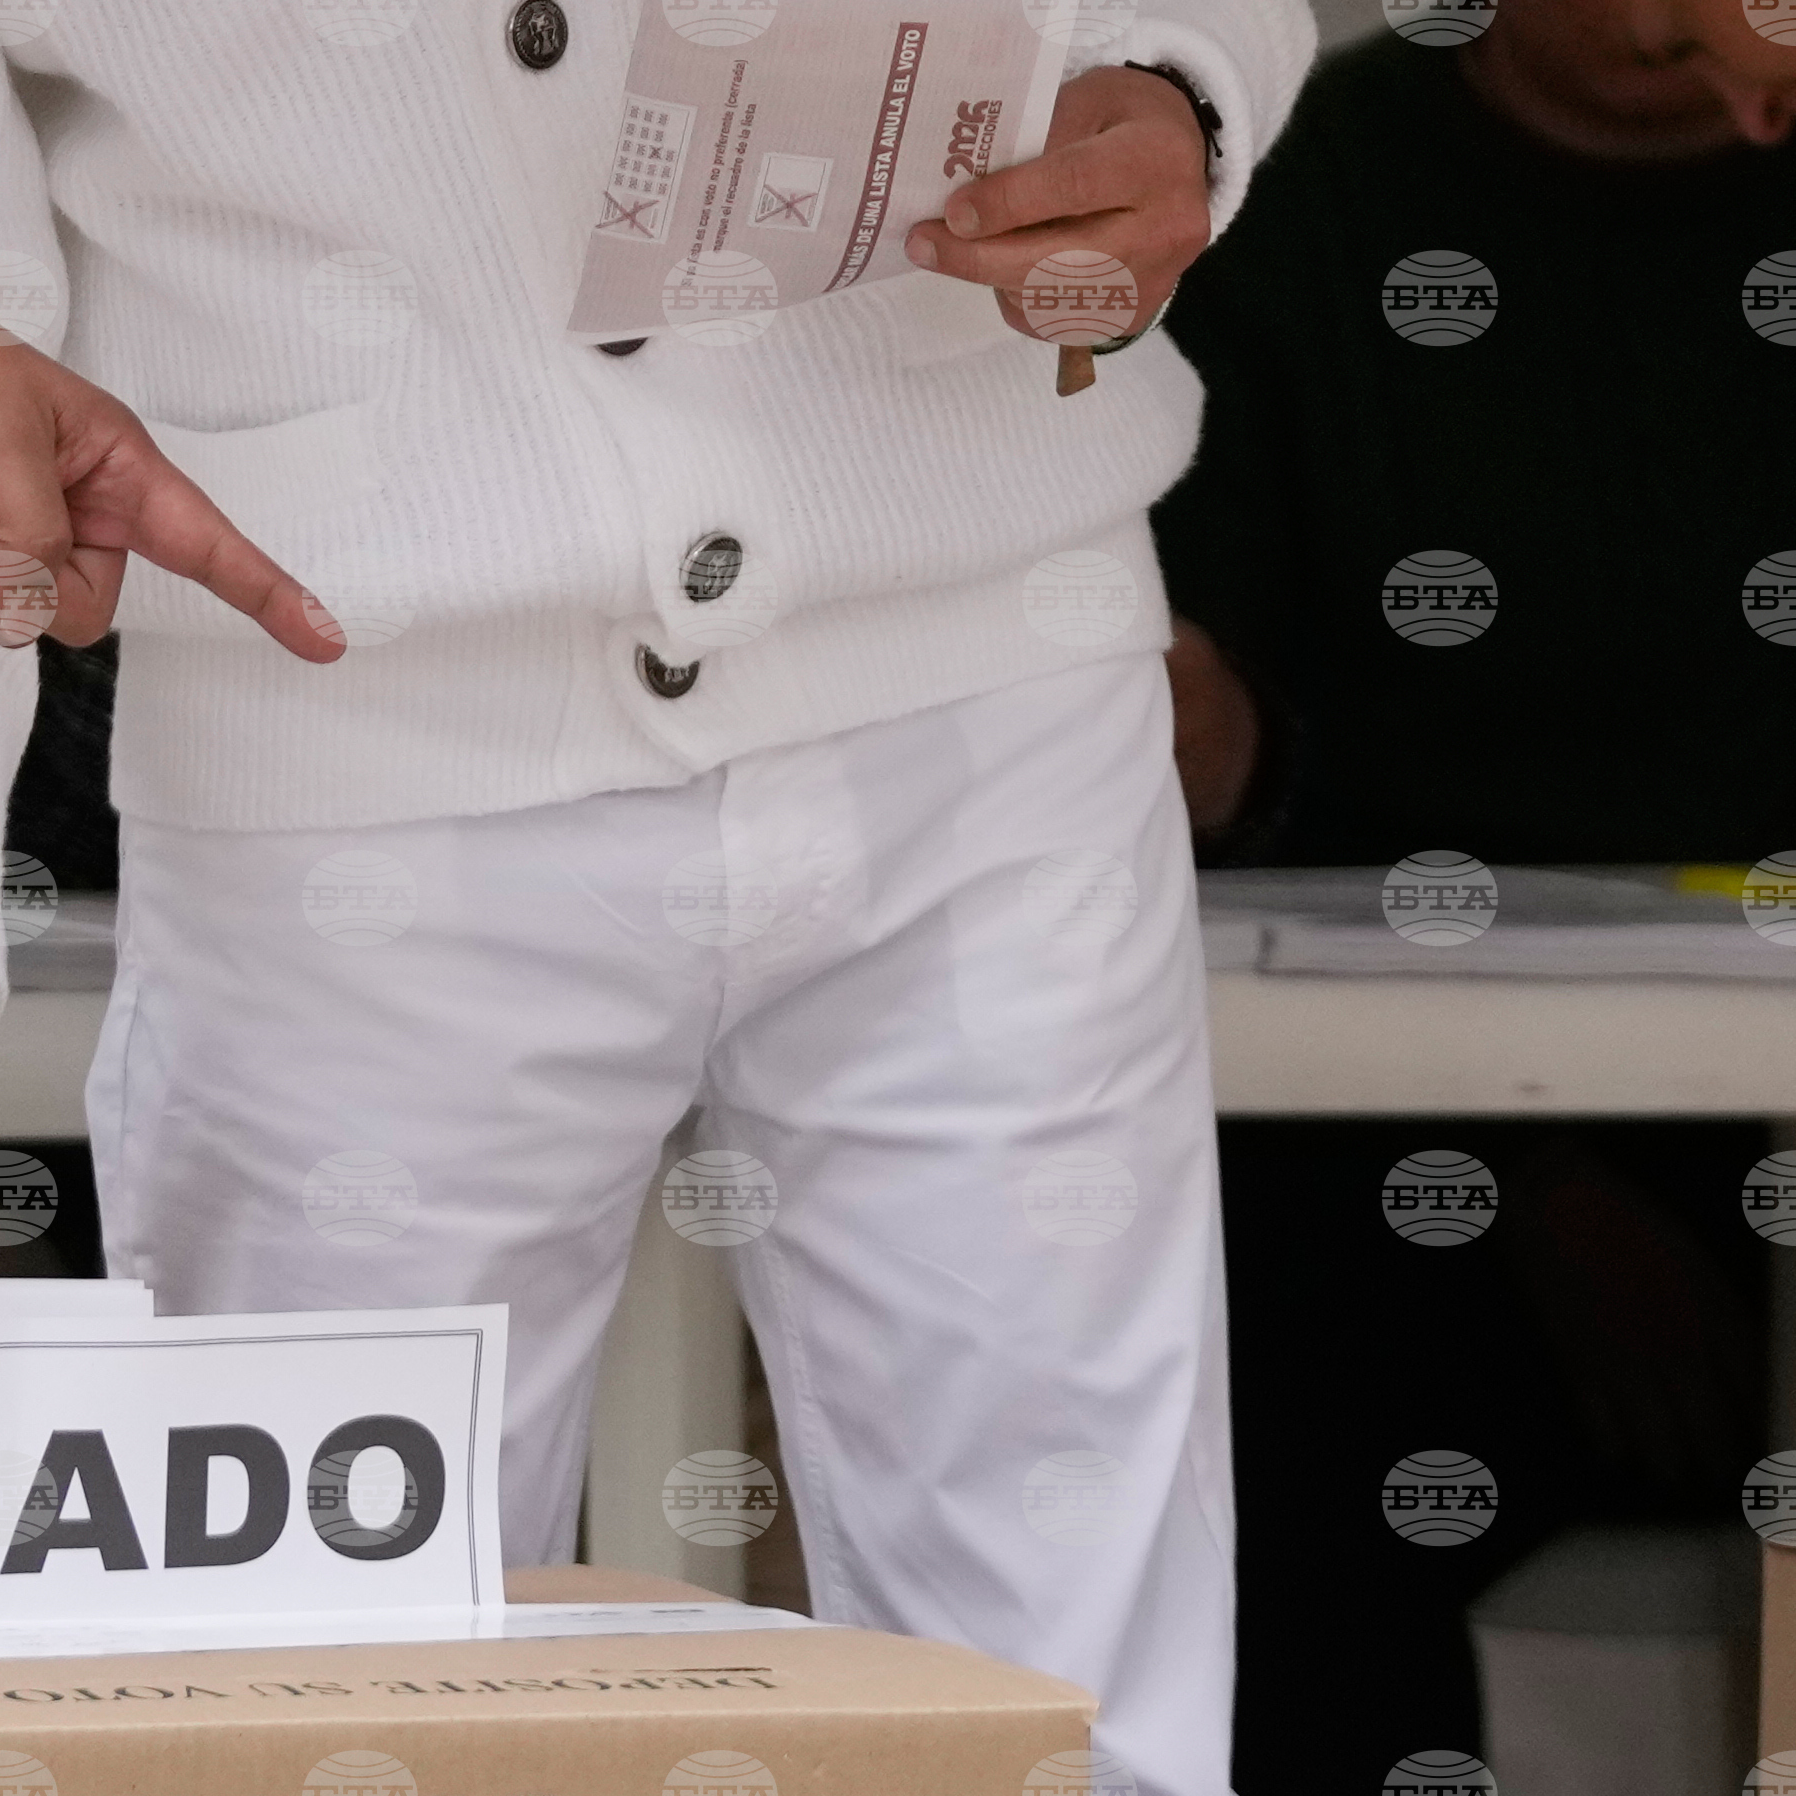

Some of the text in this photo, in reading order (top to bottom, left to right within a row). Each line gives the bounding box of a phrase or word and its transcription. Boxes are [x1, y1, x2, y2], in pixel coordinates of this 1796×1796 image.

[896, 29, 921, 70] VOTO
[892, 74, 911, 92] EL
[741, 104, 756, 126] lista
[879, 97, 905, 148] ANULA
[713, 112, 734, 165] preferente
[740, 129, 751, 139] la
[974, 100, 1002, 178] ELECCIONES
[736, 142, 747, 154] de
[710, 169, 720, 181] no
[726, 158, 744, 203] recuadro
[869, 151, 893, 196] LISTA
[704, 185, 717, 205] voto
[699, 209, 711, 227] con
[721, 206, 731, 216] el
[862, 200, 883, 226] UNA
[695, 229, 705, 240] es
[856, 228, 874, 243] DE
[3, 1684, 231, 1702] VOTO
[248, 1677, 353, 1697] SU
[369, 1677, 778, 1695] DEPOSITE
